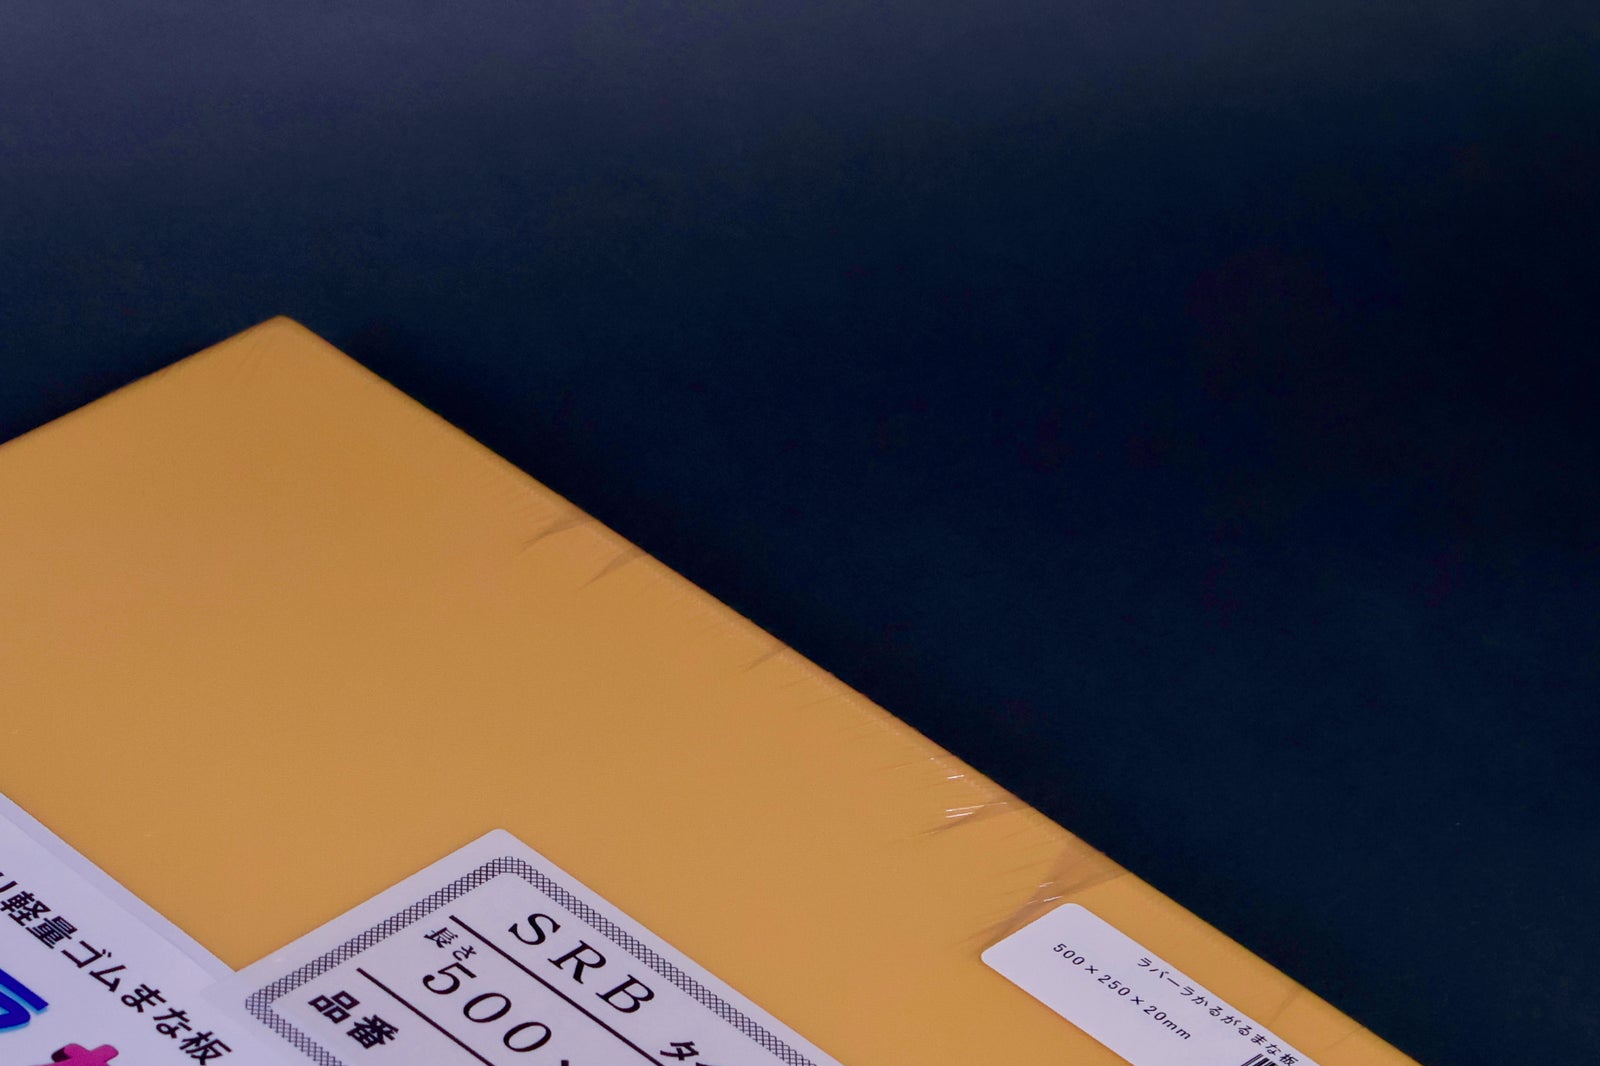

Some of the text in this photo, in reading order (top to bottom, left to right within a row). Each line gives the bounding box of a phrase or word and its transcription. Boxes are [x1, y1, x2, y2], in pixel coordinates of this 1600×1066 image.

[424, 927, 479, 960] 長さ
[508, 911, 659, 1017] SRB
[309, 988, 400, 1052] 品番
